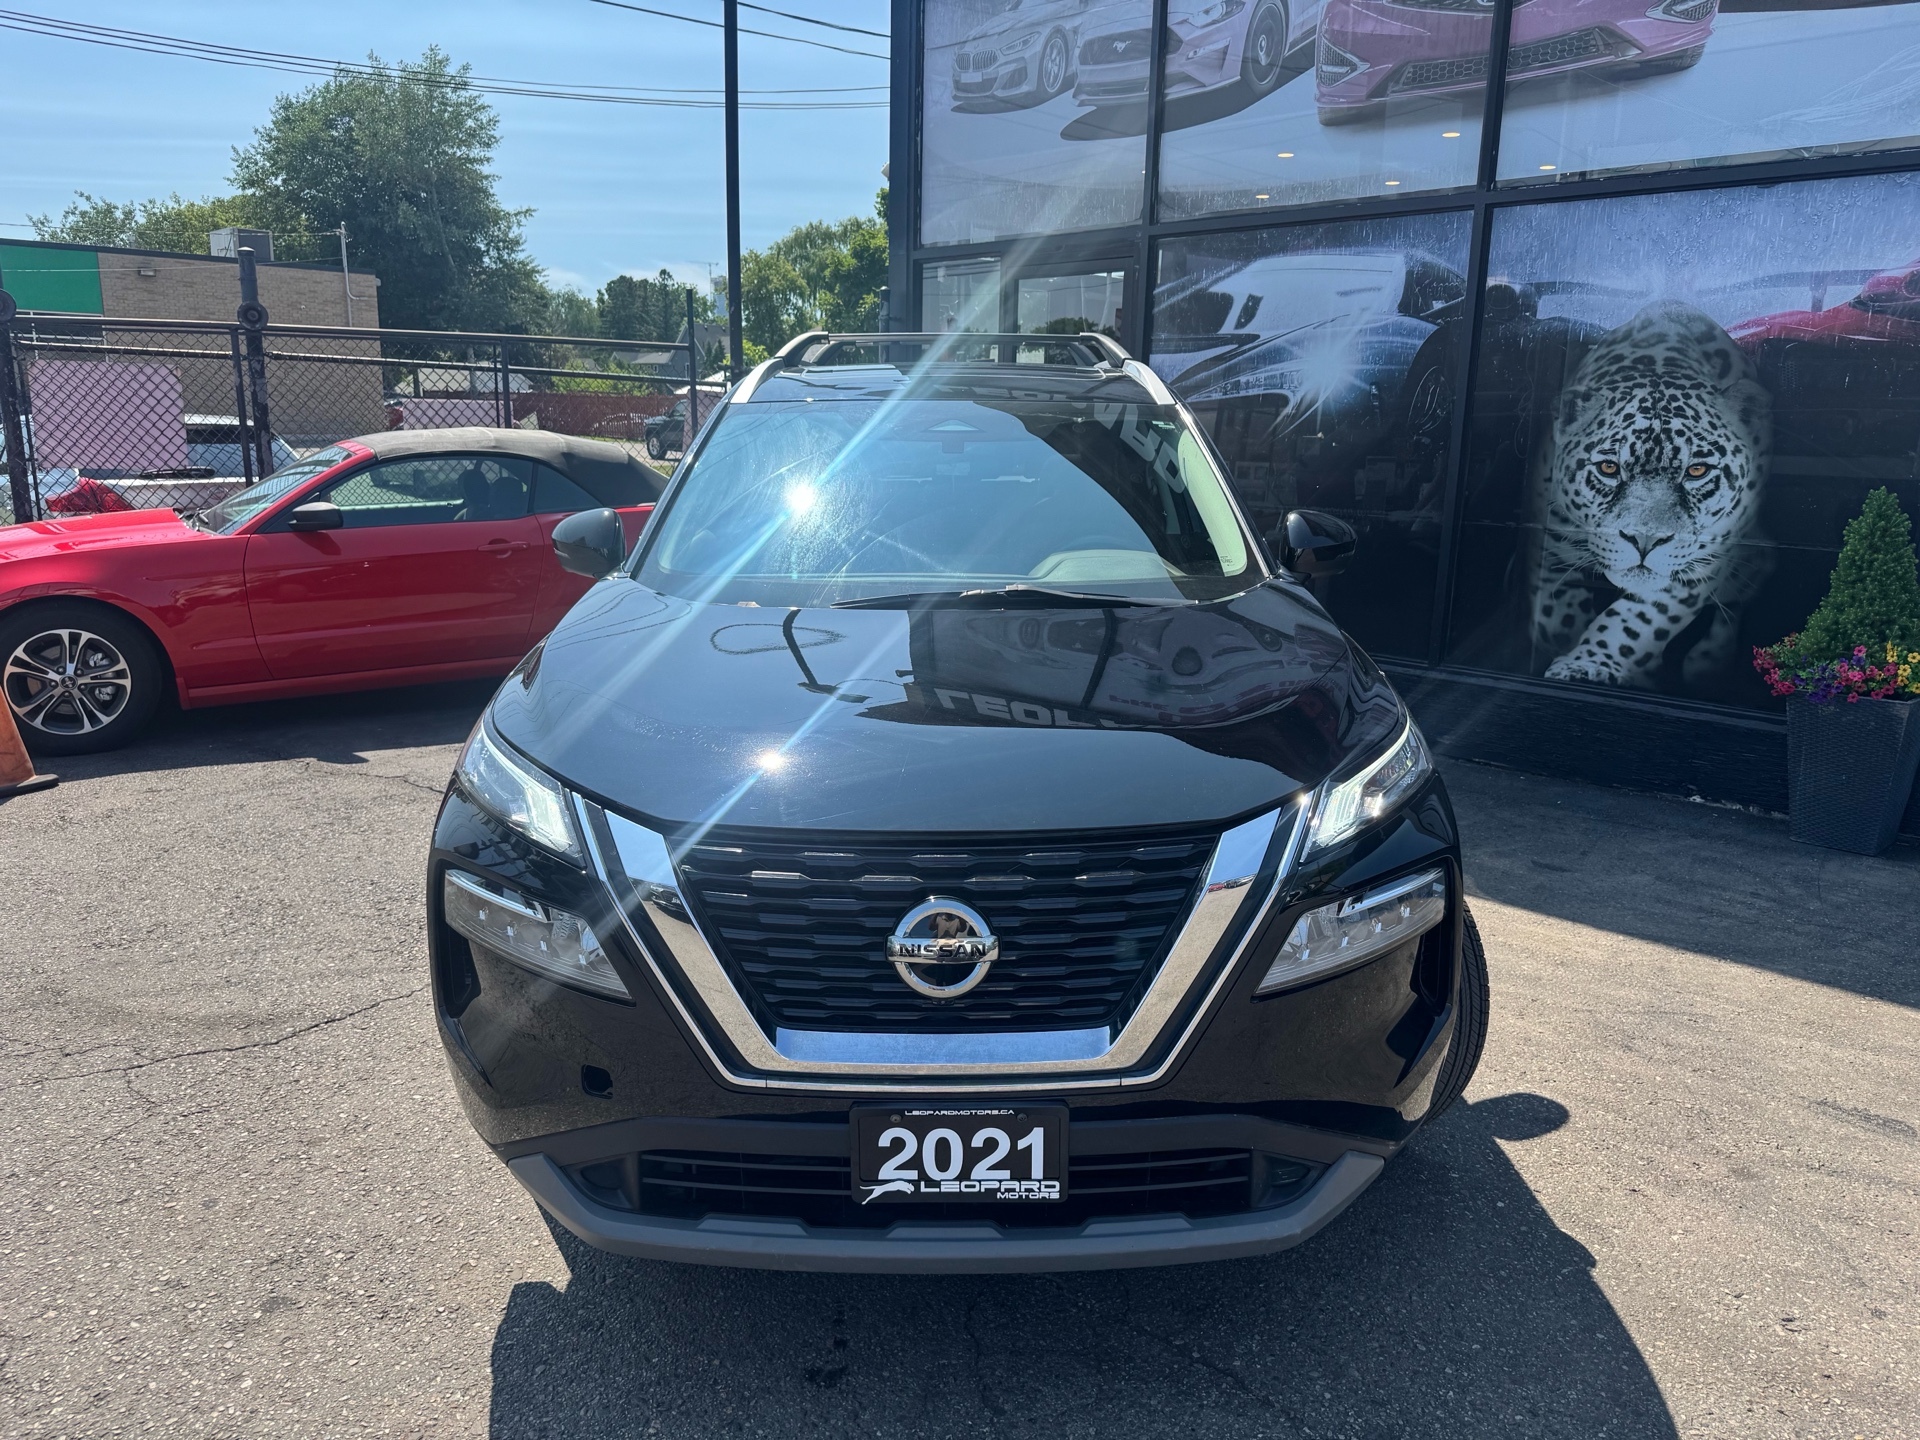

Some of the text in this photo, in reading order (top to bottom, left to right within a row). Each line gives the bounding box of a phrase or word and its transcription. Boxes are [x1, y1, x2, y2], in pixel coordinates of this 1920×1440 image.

[899, 943, 987, 958] NISSAN
[877, 1126, 1045, 1181] 2021
[920, 1180, 1061, 1193] LEOPARD
